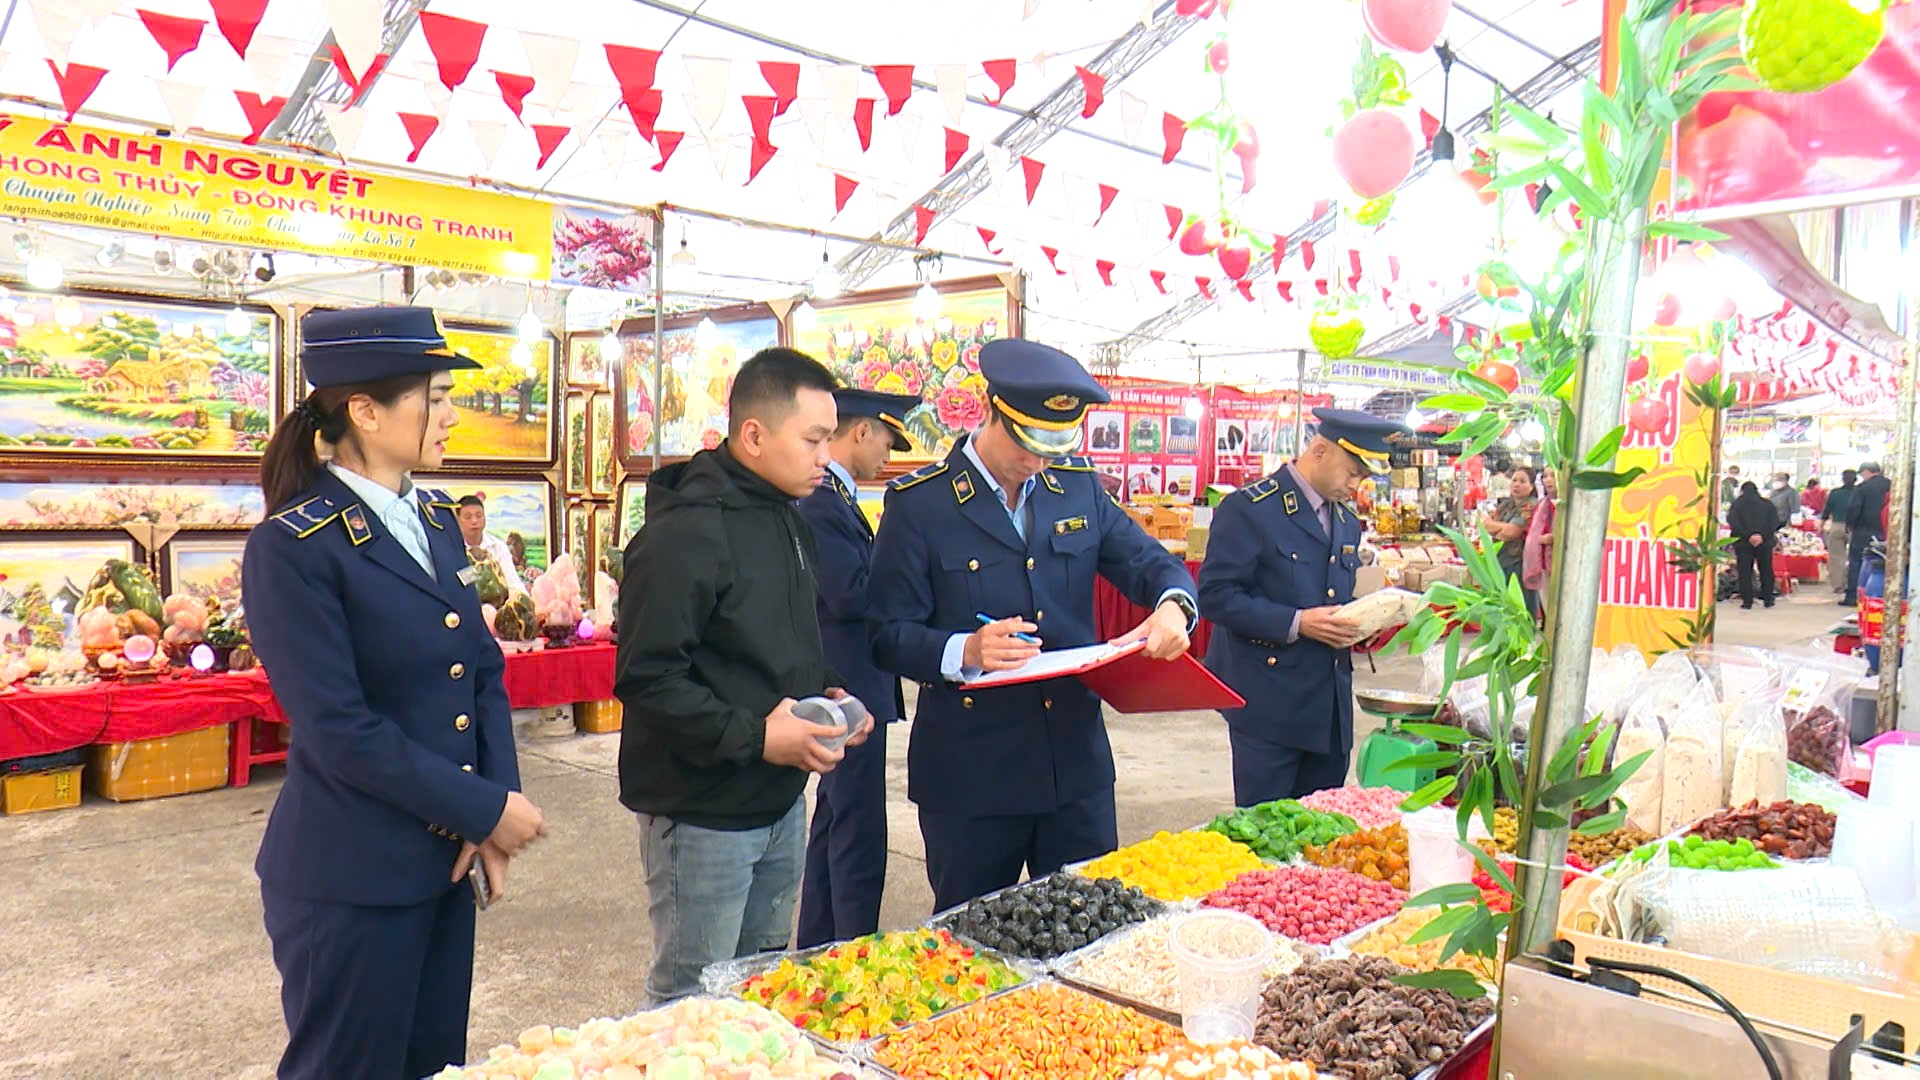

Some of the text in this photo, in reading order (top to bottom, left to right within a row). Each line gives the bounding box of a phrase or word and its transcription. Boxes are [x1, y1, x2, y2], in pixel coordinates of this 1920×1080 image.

[184, 149, 374, 200] NGUYỆT
[330, 203, 423, 230] KHUNG
[432, 219, 513, 243] TRANH
[1601, 528, 1697, 610] THÀNH
